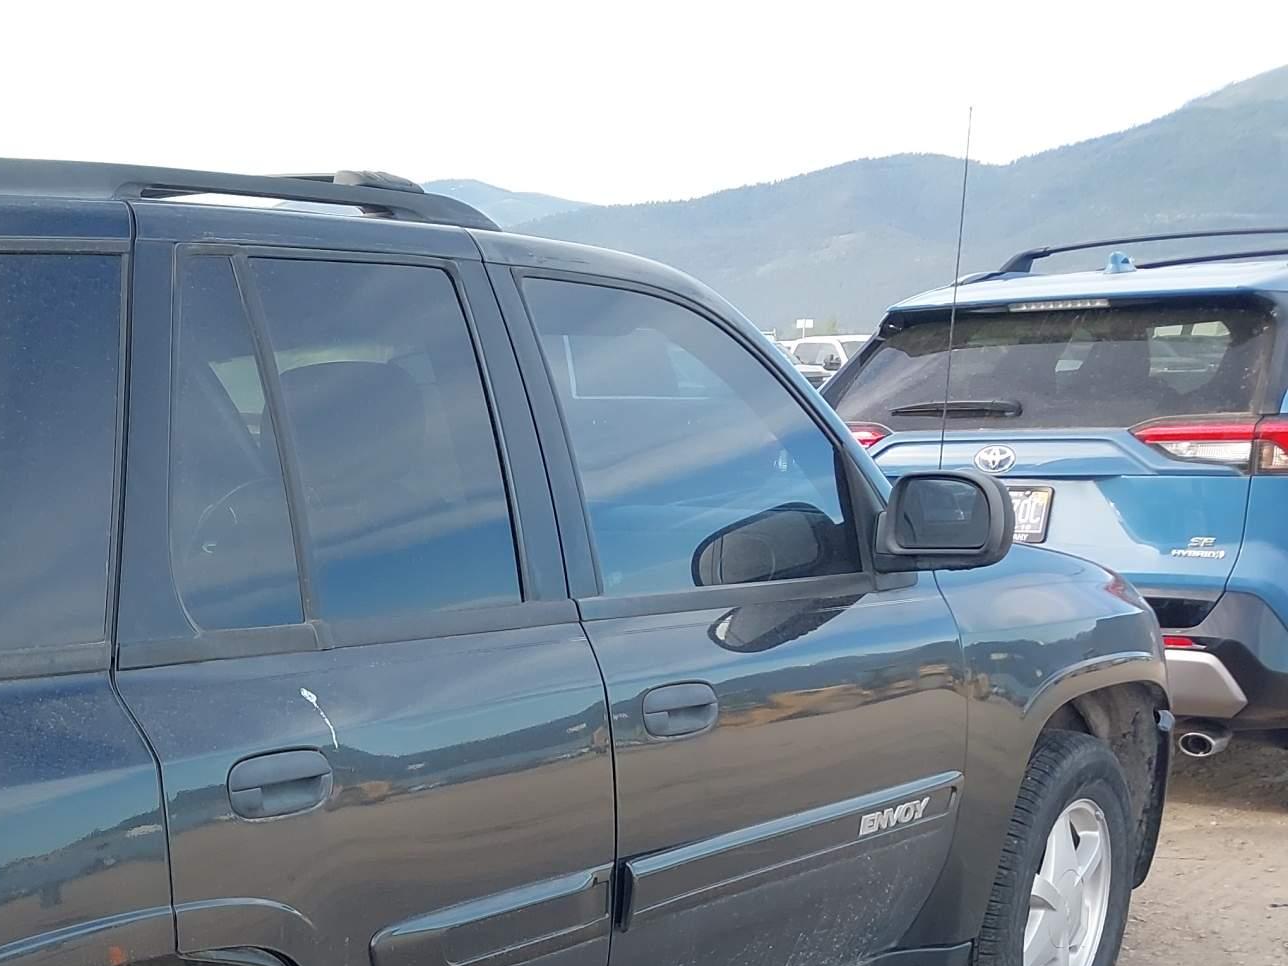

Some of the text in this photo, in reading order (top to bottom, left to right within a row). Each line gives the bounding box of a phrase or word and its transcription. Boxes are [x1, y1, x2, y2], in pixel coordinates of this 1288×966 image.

[1187, 536, 1216, 547] SE
[1171, 549, 1216, 559] HYBRID
[858, 796, 930, 837] ENVOY
